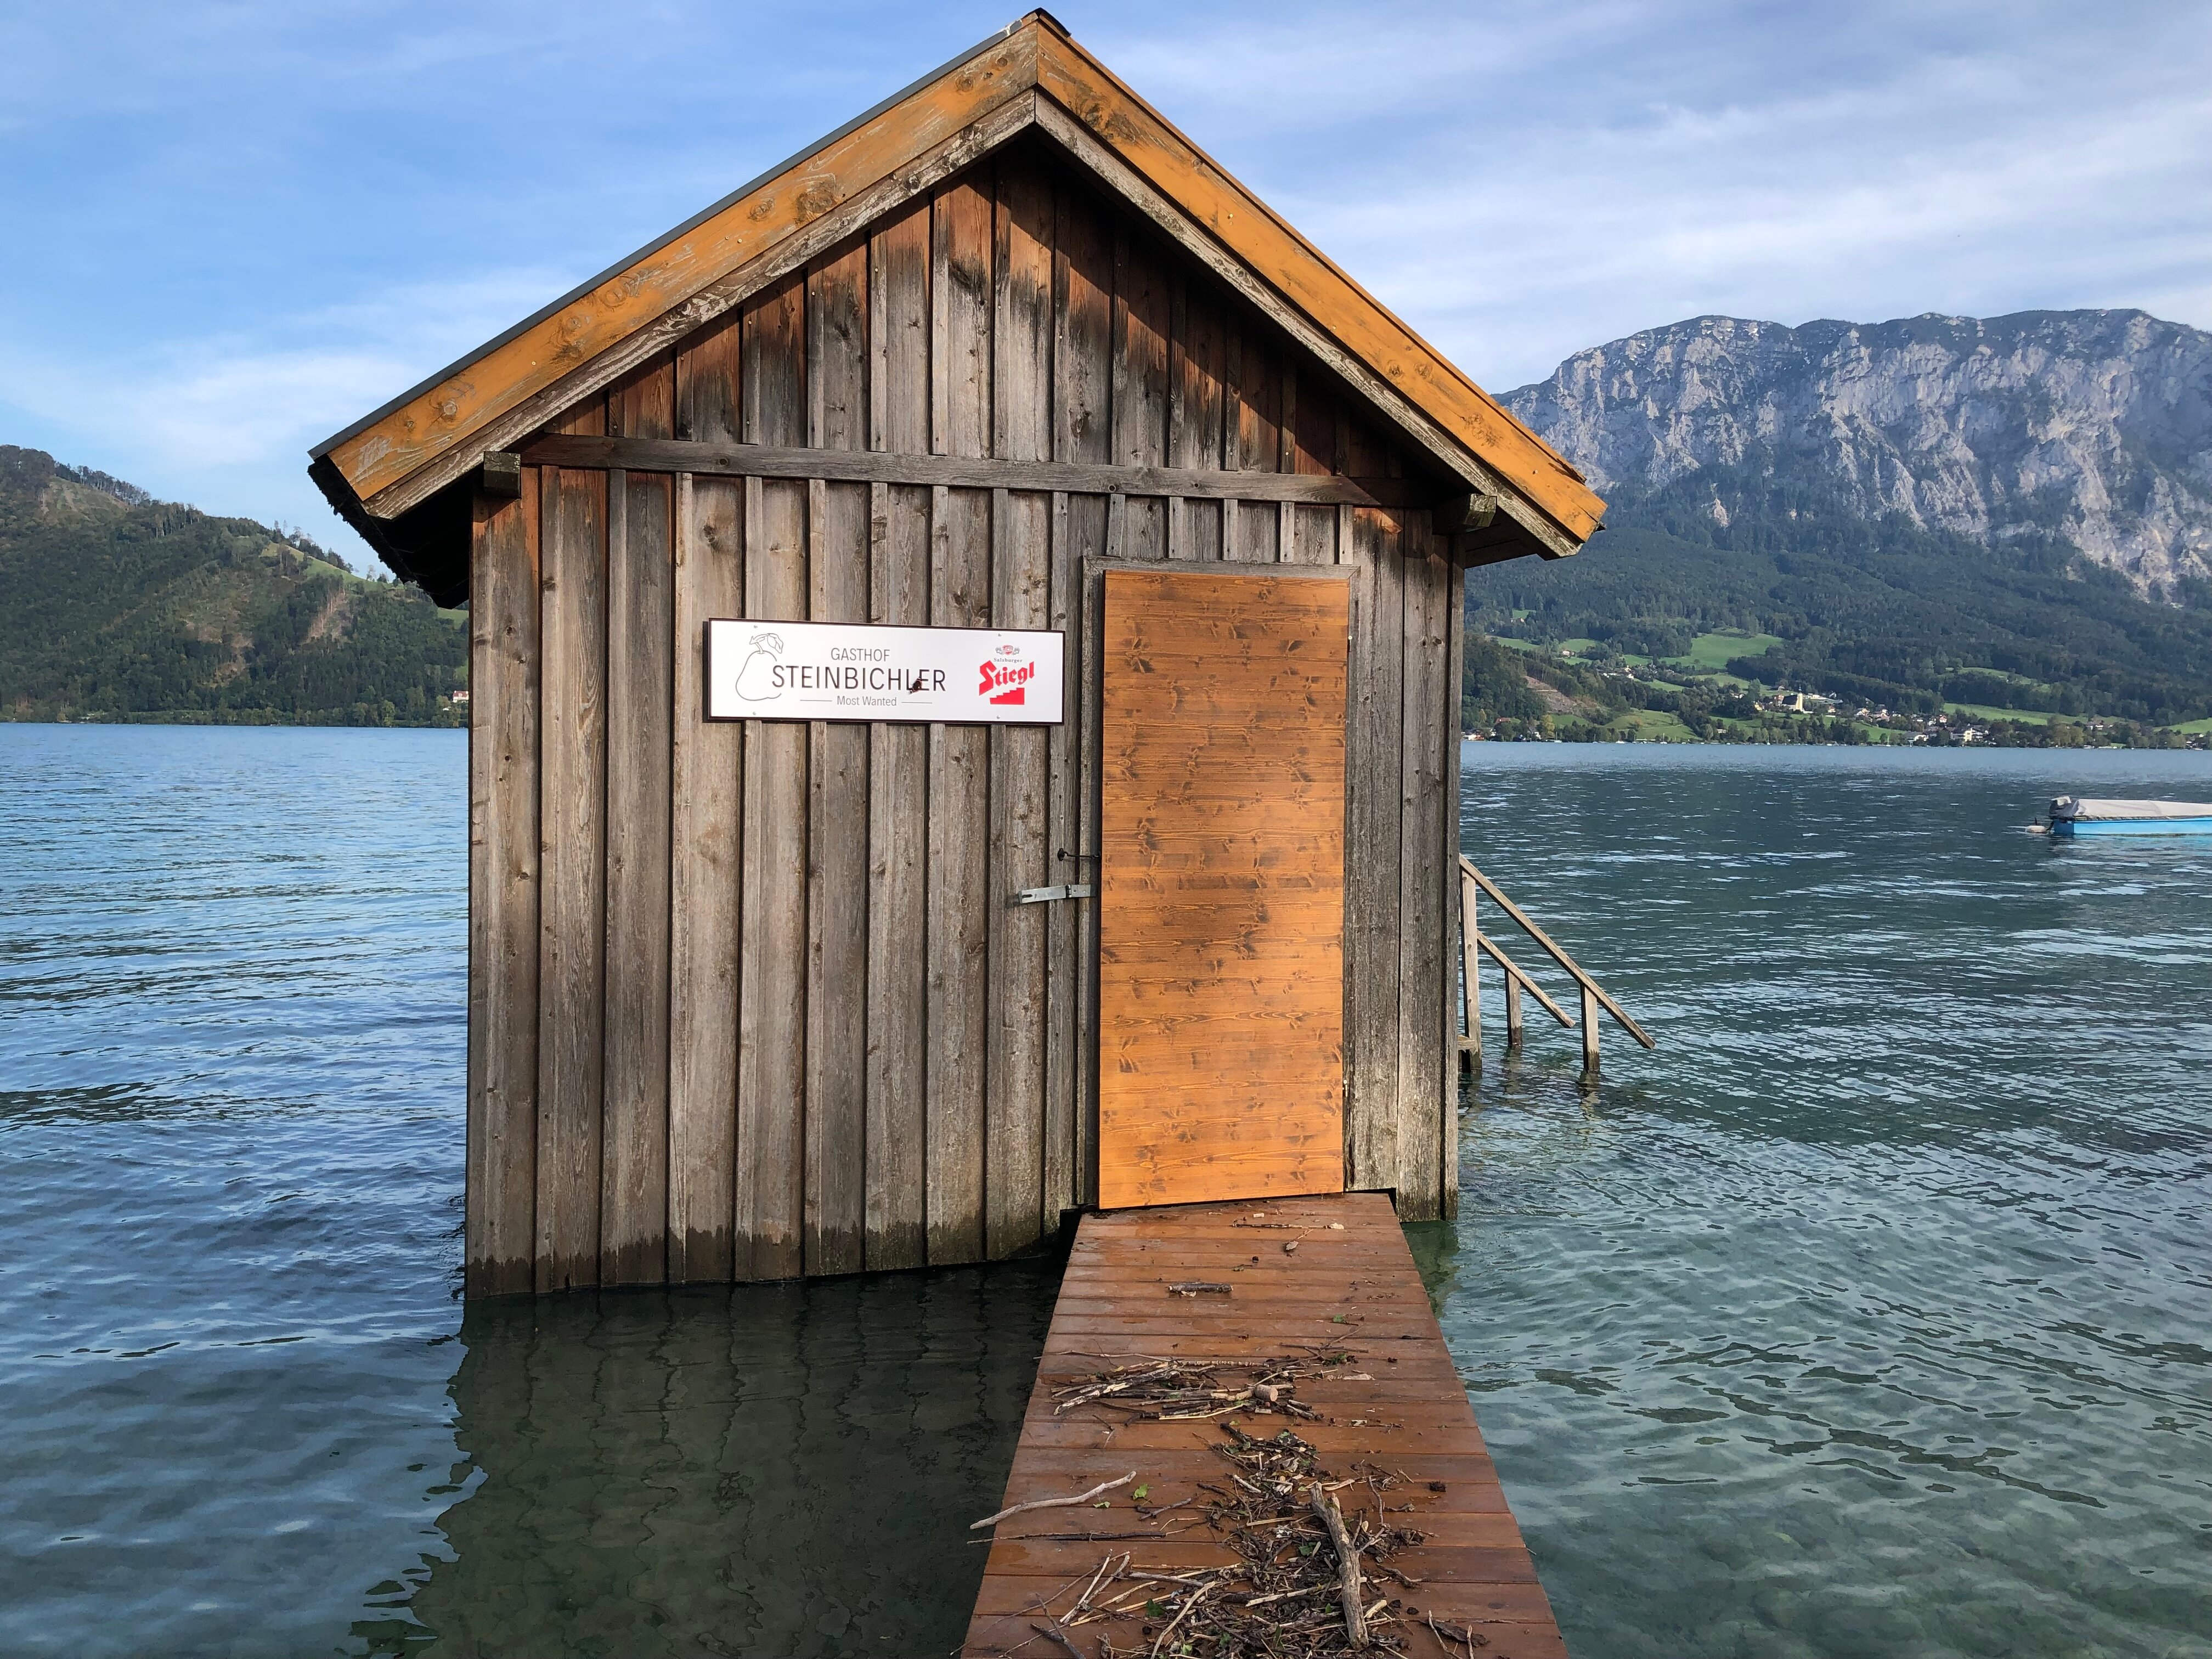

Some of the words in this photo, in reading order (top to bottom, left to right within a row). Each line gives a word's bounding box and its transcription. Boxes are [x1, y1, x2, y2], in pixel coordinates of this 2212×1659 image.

[831, 647, 890, 662] GASTHOF
[772, 665, 946, 692] STEINBICHLER
[979, 660, 1035, 696] Stiegl
[837, 696, 860, 706] Most
[862, 696, 897, 707] Wanted
